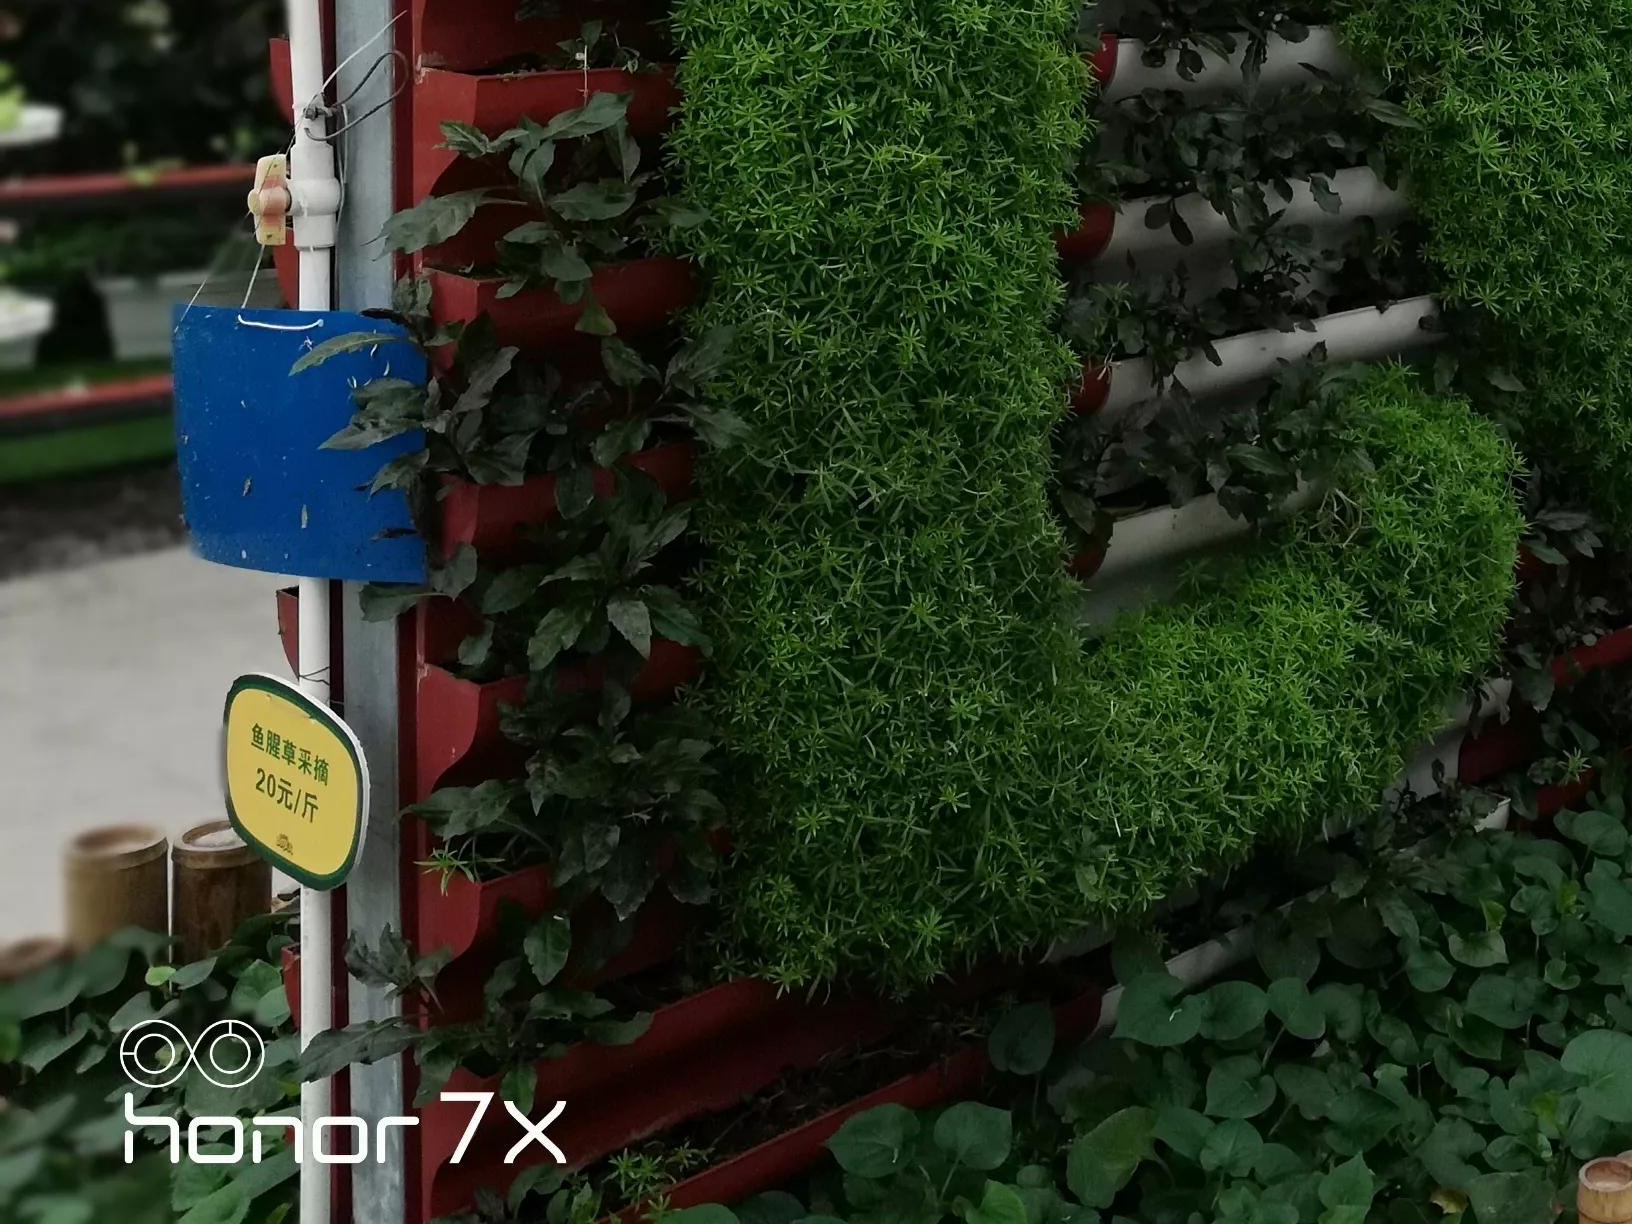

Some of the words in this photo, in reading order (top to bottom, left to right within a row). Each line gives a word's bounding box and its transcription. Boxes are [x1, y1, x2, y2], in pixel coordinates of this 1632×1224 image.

[251, 722, 330, 787] 鱼腥草采摘
[255, 767, 320, 824] 20元/斤
